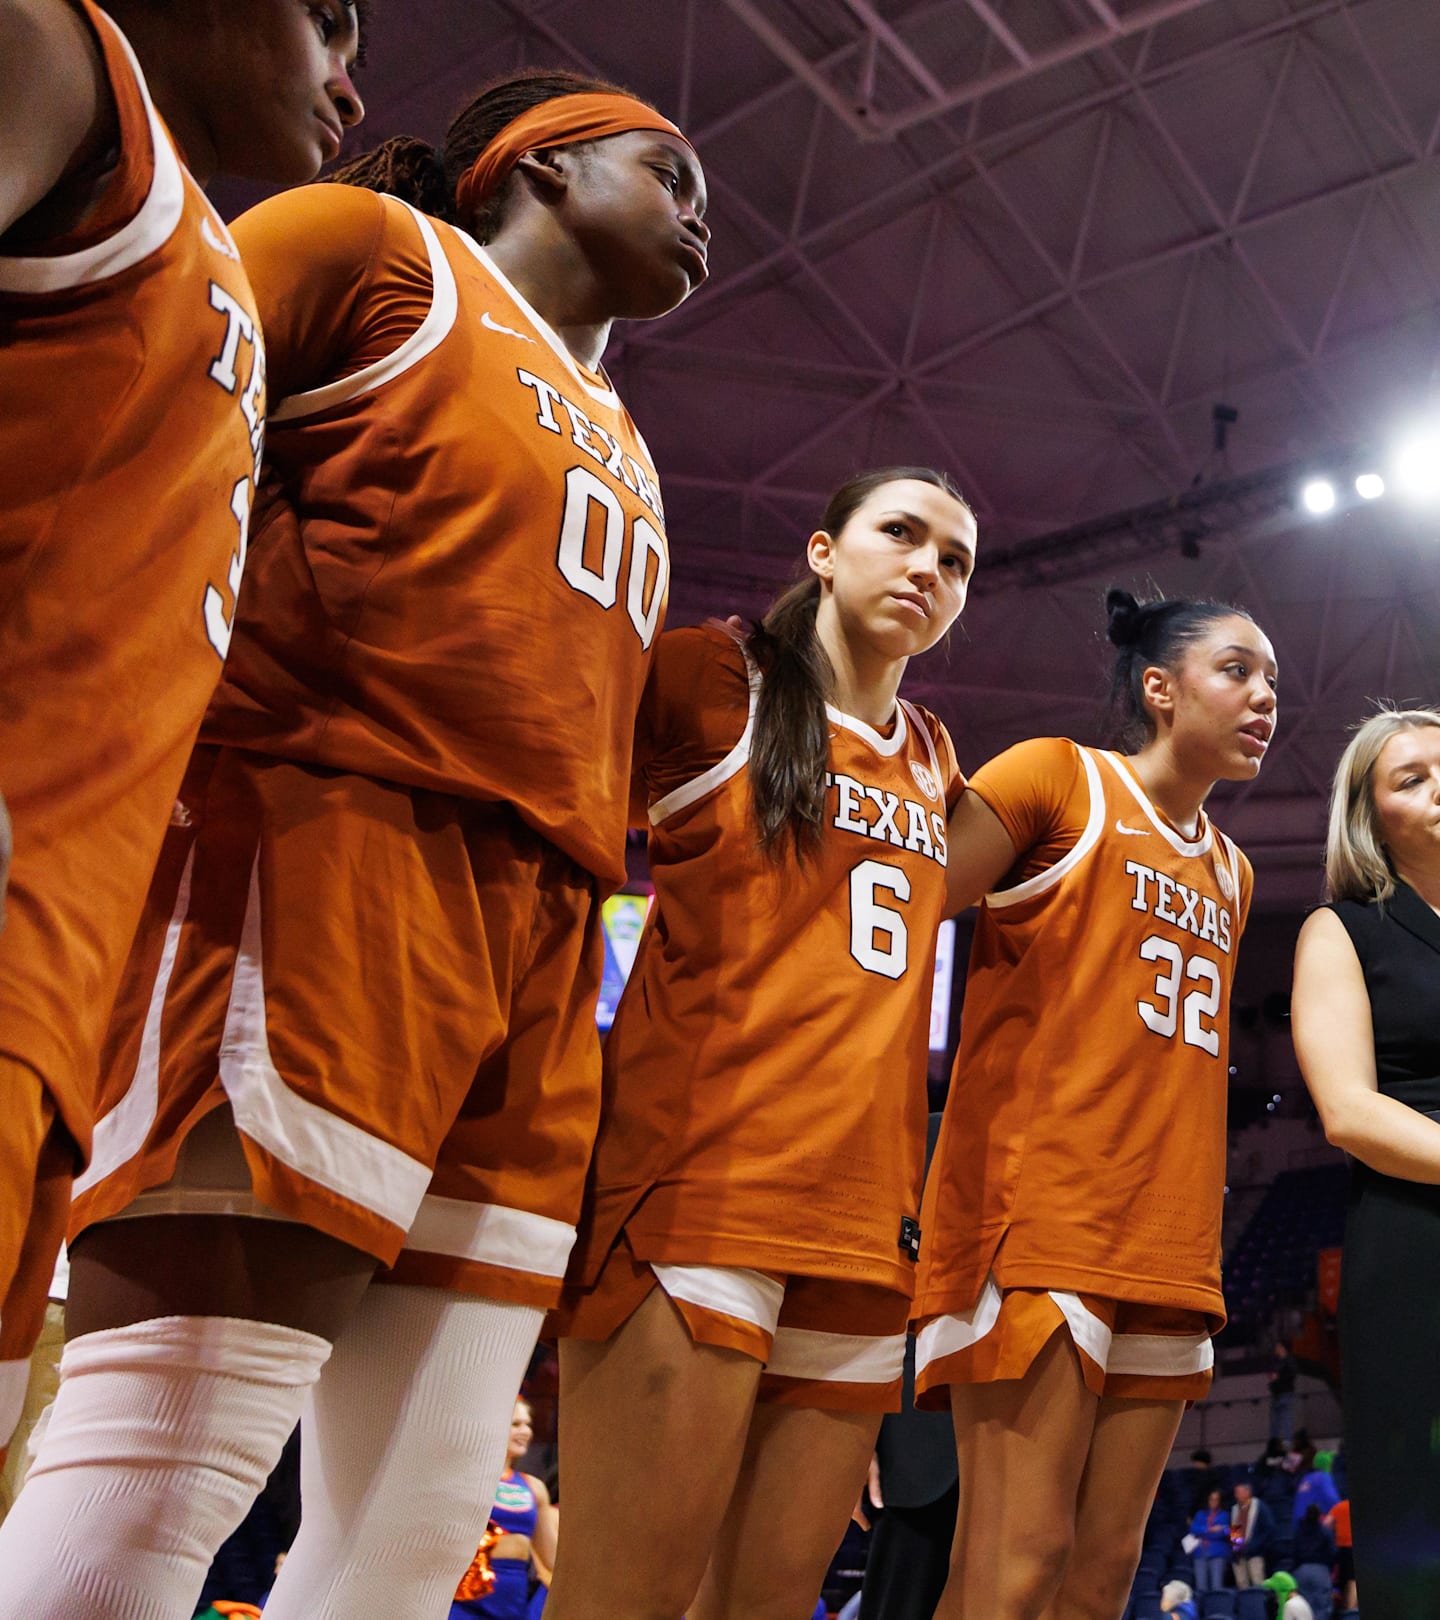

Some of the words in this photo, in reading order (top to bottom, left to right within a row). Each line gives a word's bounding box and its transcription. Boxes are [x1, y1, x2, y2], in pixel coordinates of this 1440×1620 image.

[556, 464, 669, 653] 00
[825, 771, 948, 868] EXAS
[848, 858, 911, 980] 6
[1125, 859, 1231, 954] TEXAS
[1137, 933, 1221, 1058] 32
